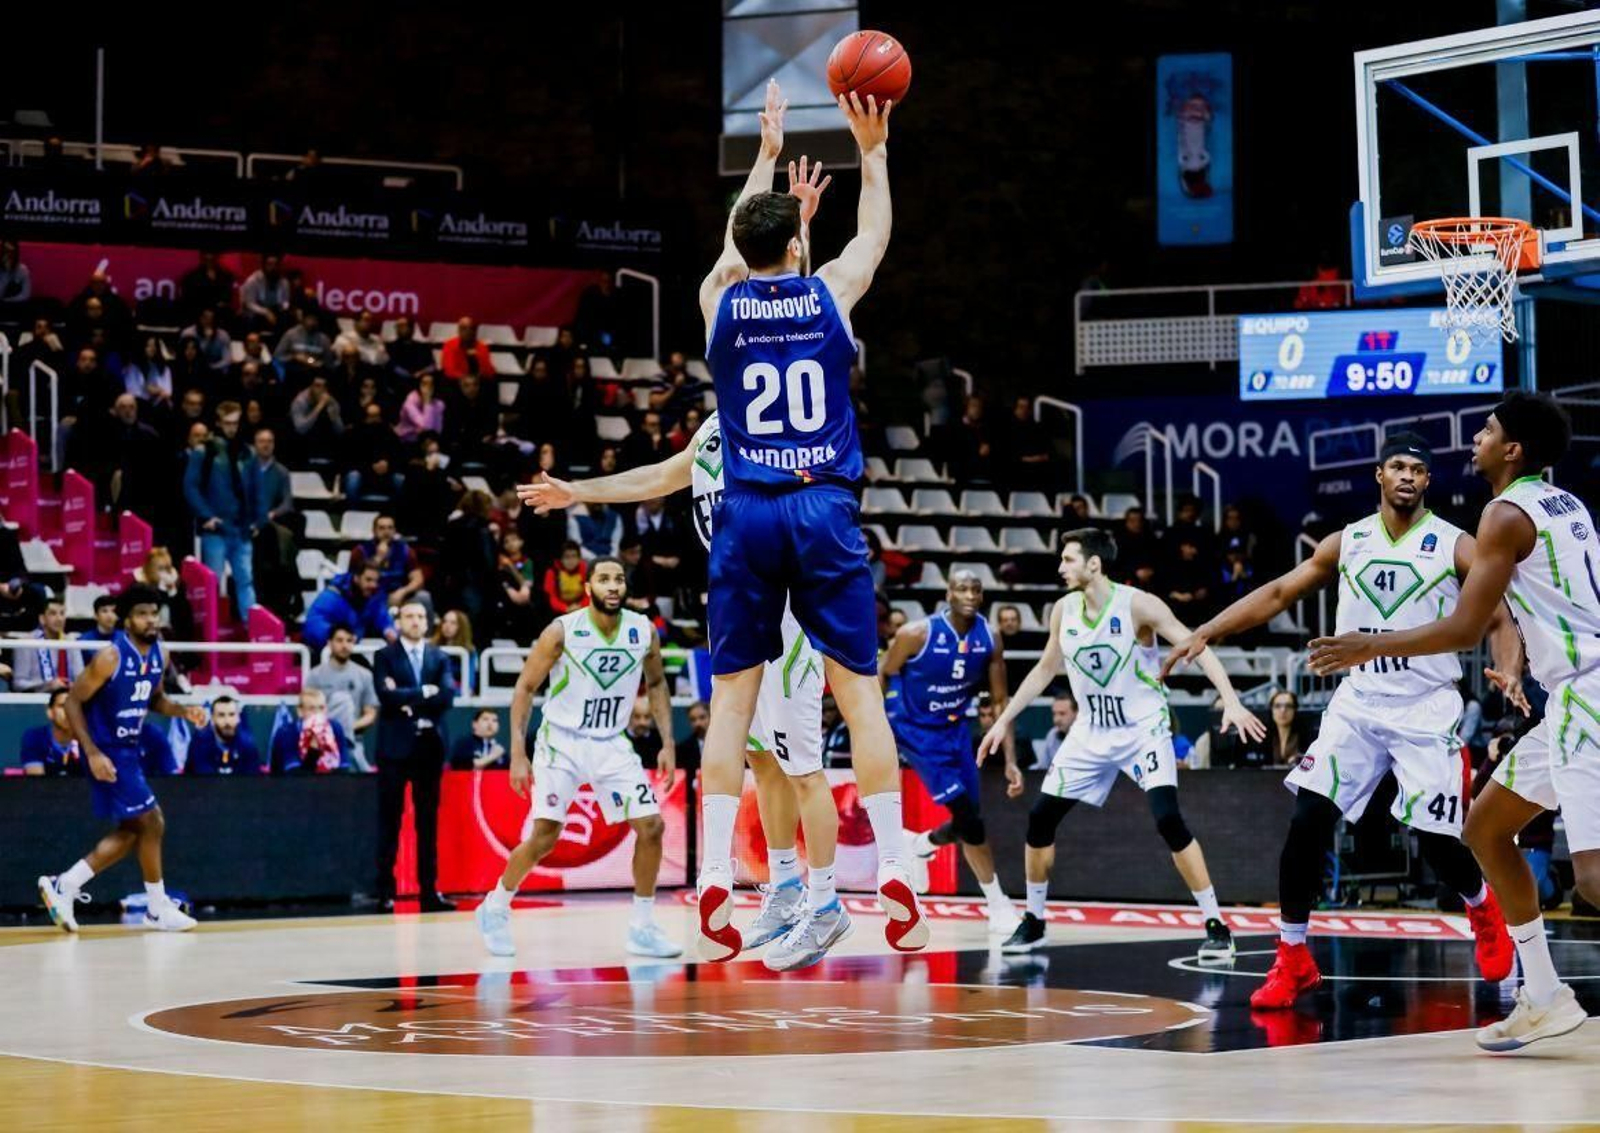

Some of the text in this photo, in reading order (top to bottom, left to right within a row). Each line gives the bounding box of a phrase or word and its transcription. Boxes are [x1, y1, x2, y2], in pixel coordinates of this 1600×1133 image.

[4, 189, 101, 215] Andorra
[152, 195, 248, 222] Andorra
[299, 204, 389, 229] Andorra
[439, 212, 527, 236] Andorra
[577, 220, 662, 243] Andorra
[316, 281, 419, 314] lecom
[731, 288, 822, 320] TODOROVIĆ
[748, 331, 824, 344] andorra telecom
[1242, 316, 1309, 335] EQUIPO
[1278, 333, 1304, 370] 0
[1447, 329, 1472, 364] 0
[1252, 372, 1266, 390] 0
[1346, 361, 1413, 391] 9:50
[1476, 365, 1489, 383] 0
[743, 360, 826, 435] 20
[1166, 421, 1300, 460] MORA
[739, 443, 836, 470] ANDORRA
[1374, 570, 1396, 591] 41
[598, 656, 620, 673] 22
[951, 659, 966, 679] 5
[1089, 652, 1102, 670] 3
[579, 696, 625, 729] FIAT
[1086, 694, 1127, 728] FIAT
[773, 730, 790, 762] 5
[1146, 751, 1160, 772] 3
[1428, 793, 1459, 824] 41
